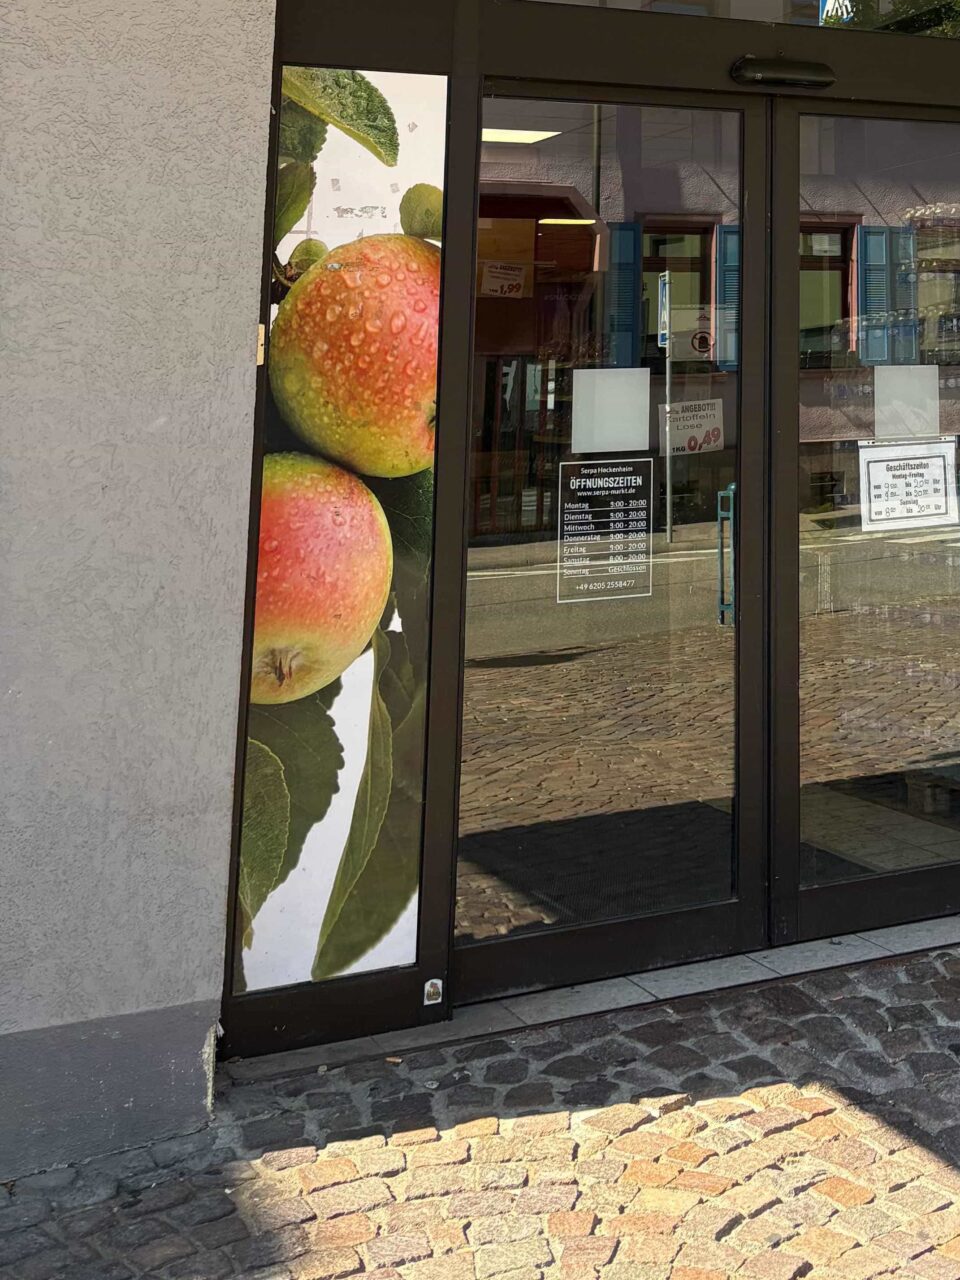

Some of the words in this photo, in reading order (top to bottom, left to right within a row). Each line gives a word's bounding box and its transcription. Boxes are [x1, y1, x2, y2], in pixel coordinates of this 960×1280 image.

[500, 282, 522, 295] 1,99
[681, 402, 716, 413] ANGEBOT!!!
[687, 426, 721, 452] 0,49
[580, 467, 597, 475] Serpa
[598, 466, 633, 474] Hockenheim
[886, 462, 930, 472] Geschäftszeiten
[570, 476, 642, 490] ÖFFNUNGSZEITEN
[577, 488, 636, 496] www.serpa-markt.de
[564, 502, 590, 510] Montag
[564, 513, 592, 521] Dienstag
[564, 524, 595, 532] Mittwoch
[588, 582, 606, 590] 6205
